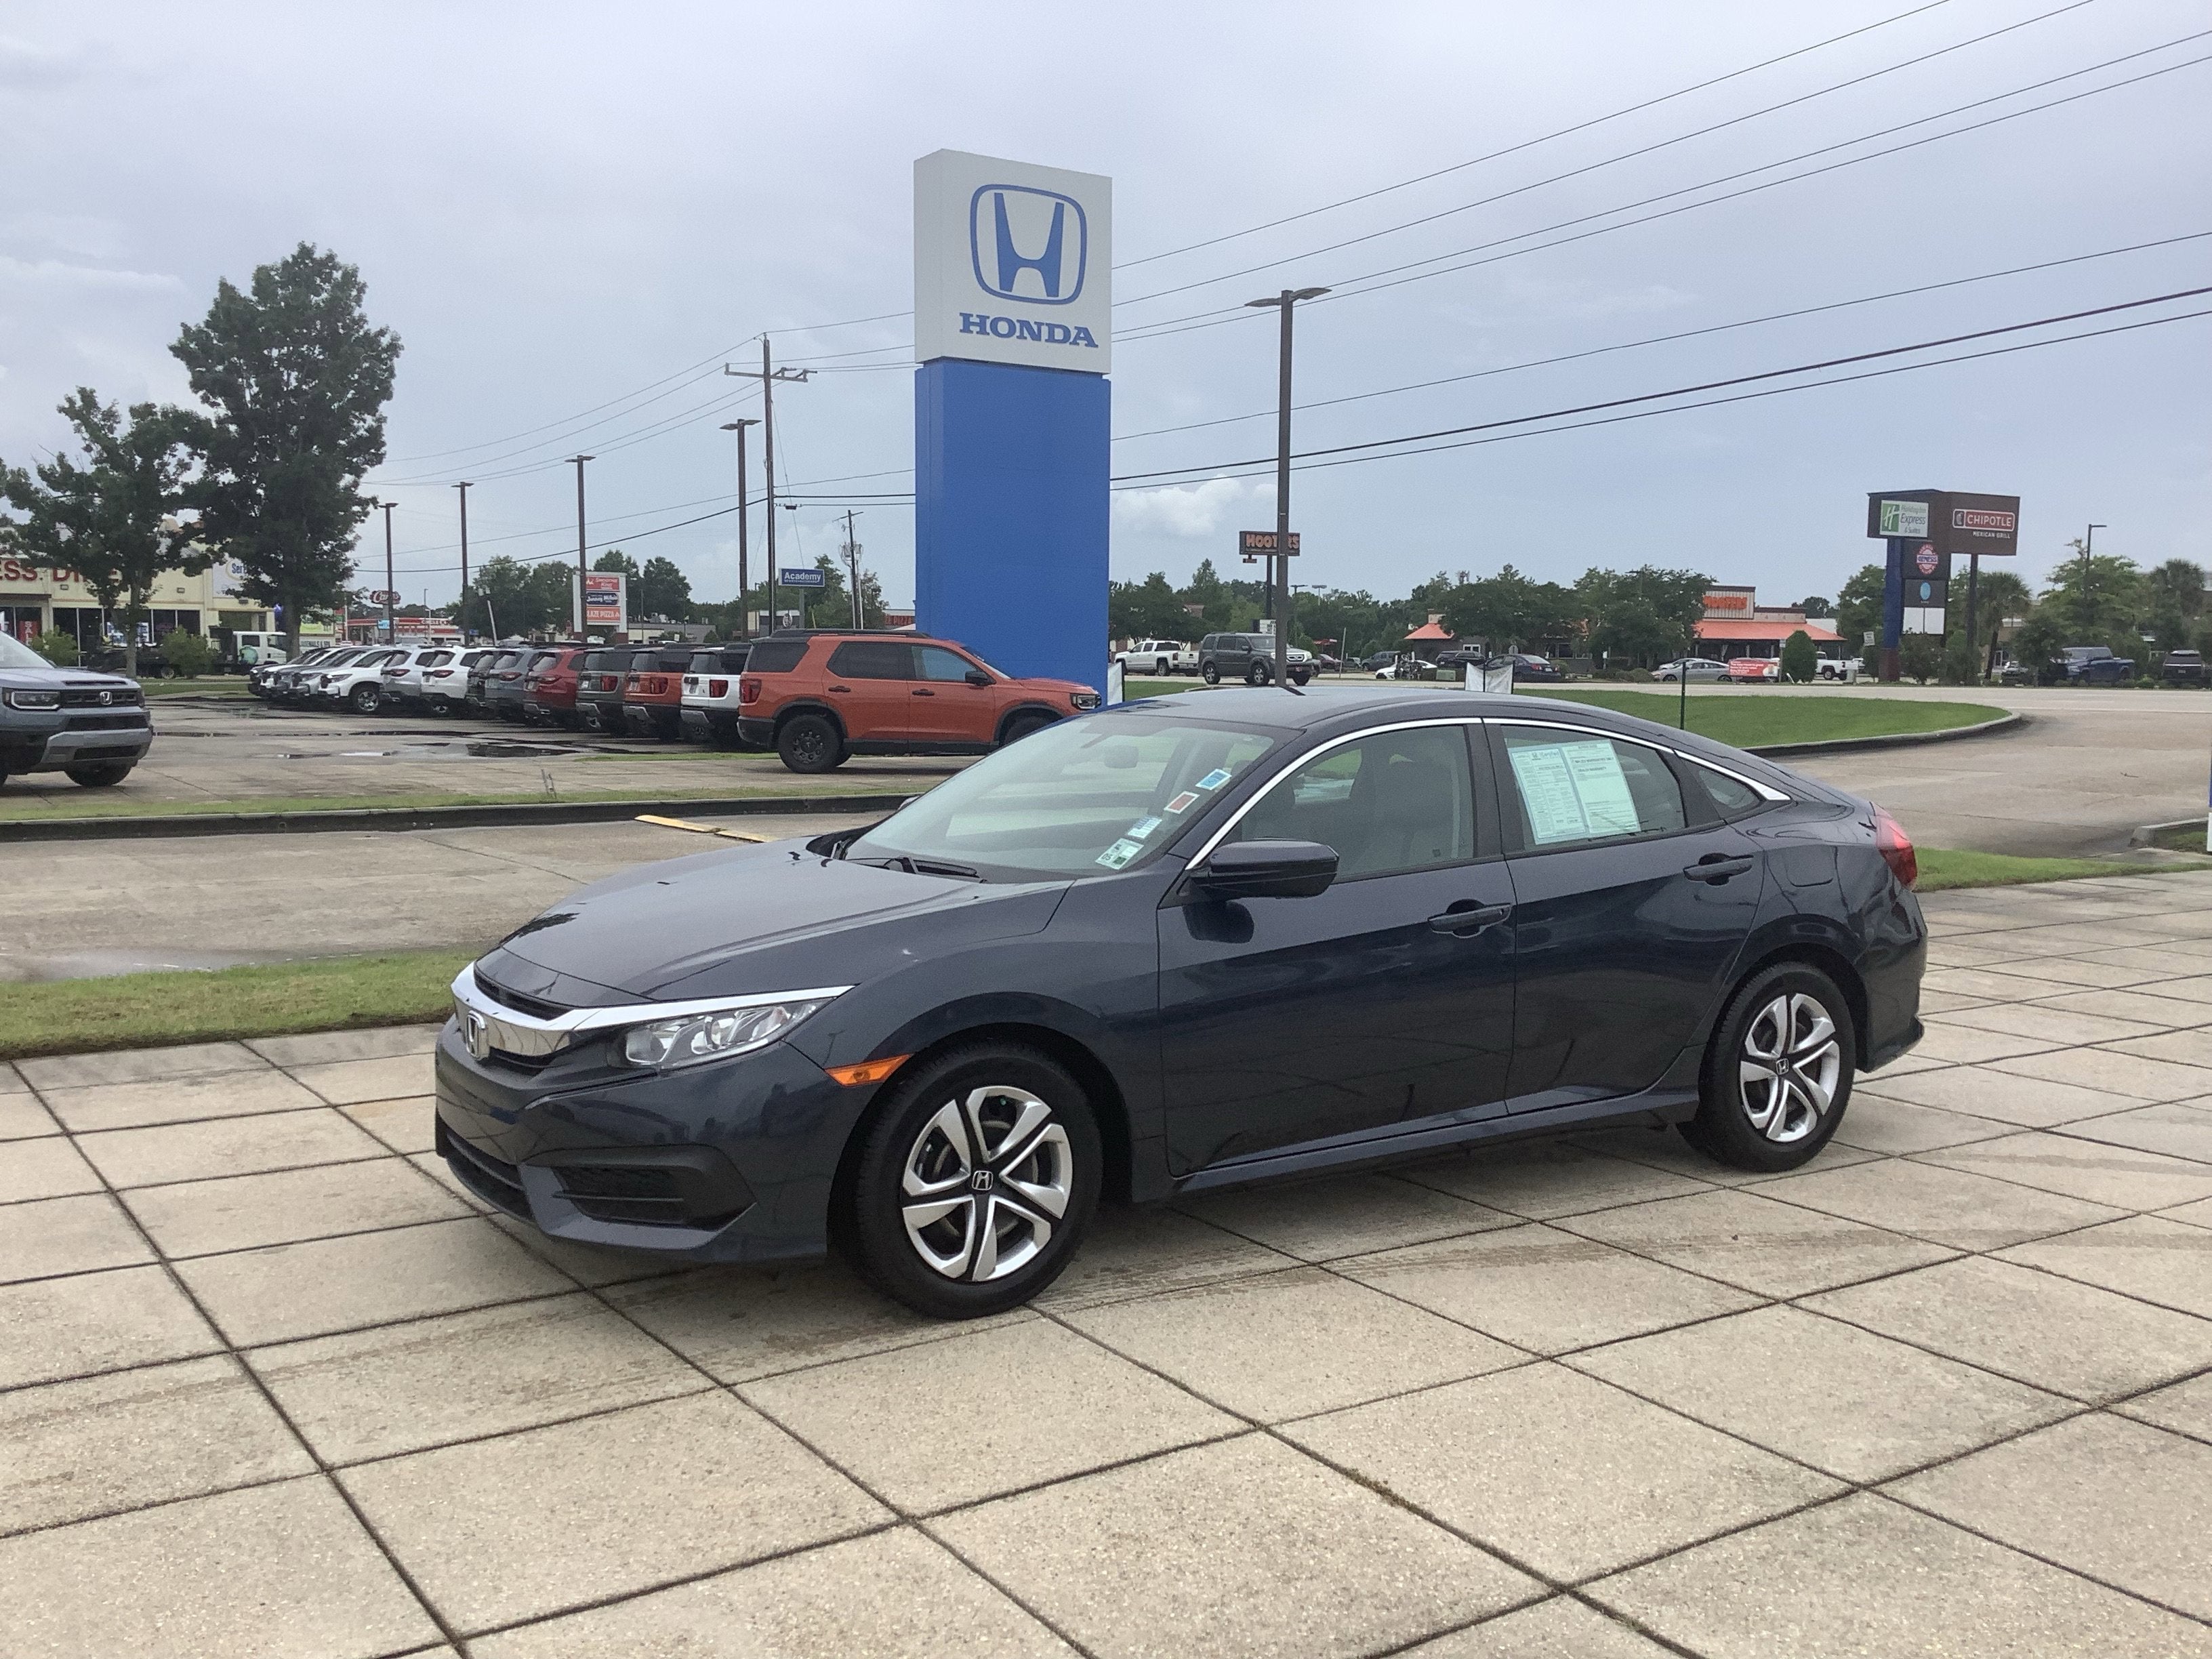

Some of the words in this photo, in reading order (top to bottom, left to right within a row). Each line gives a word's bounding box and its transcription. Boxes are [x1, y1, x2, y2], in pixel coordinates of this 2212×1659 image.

[960, 312, 1099, 348] HONDA
[1900, 512, 1926, 526] Express
[1967, 514, 2012, 527] CHIPOTLE
[1246, 533, 1299, 549] HOOTRS
[0, 559, 37, 581] SS
[784, 571, 821, 583] Academy
[586, 610, 599, 618] LAZE
